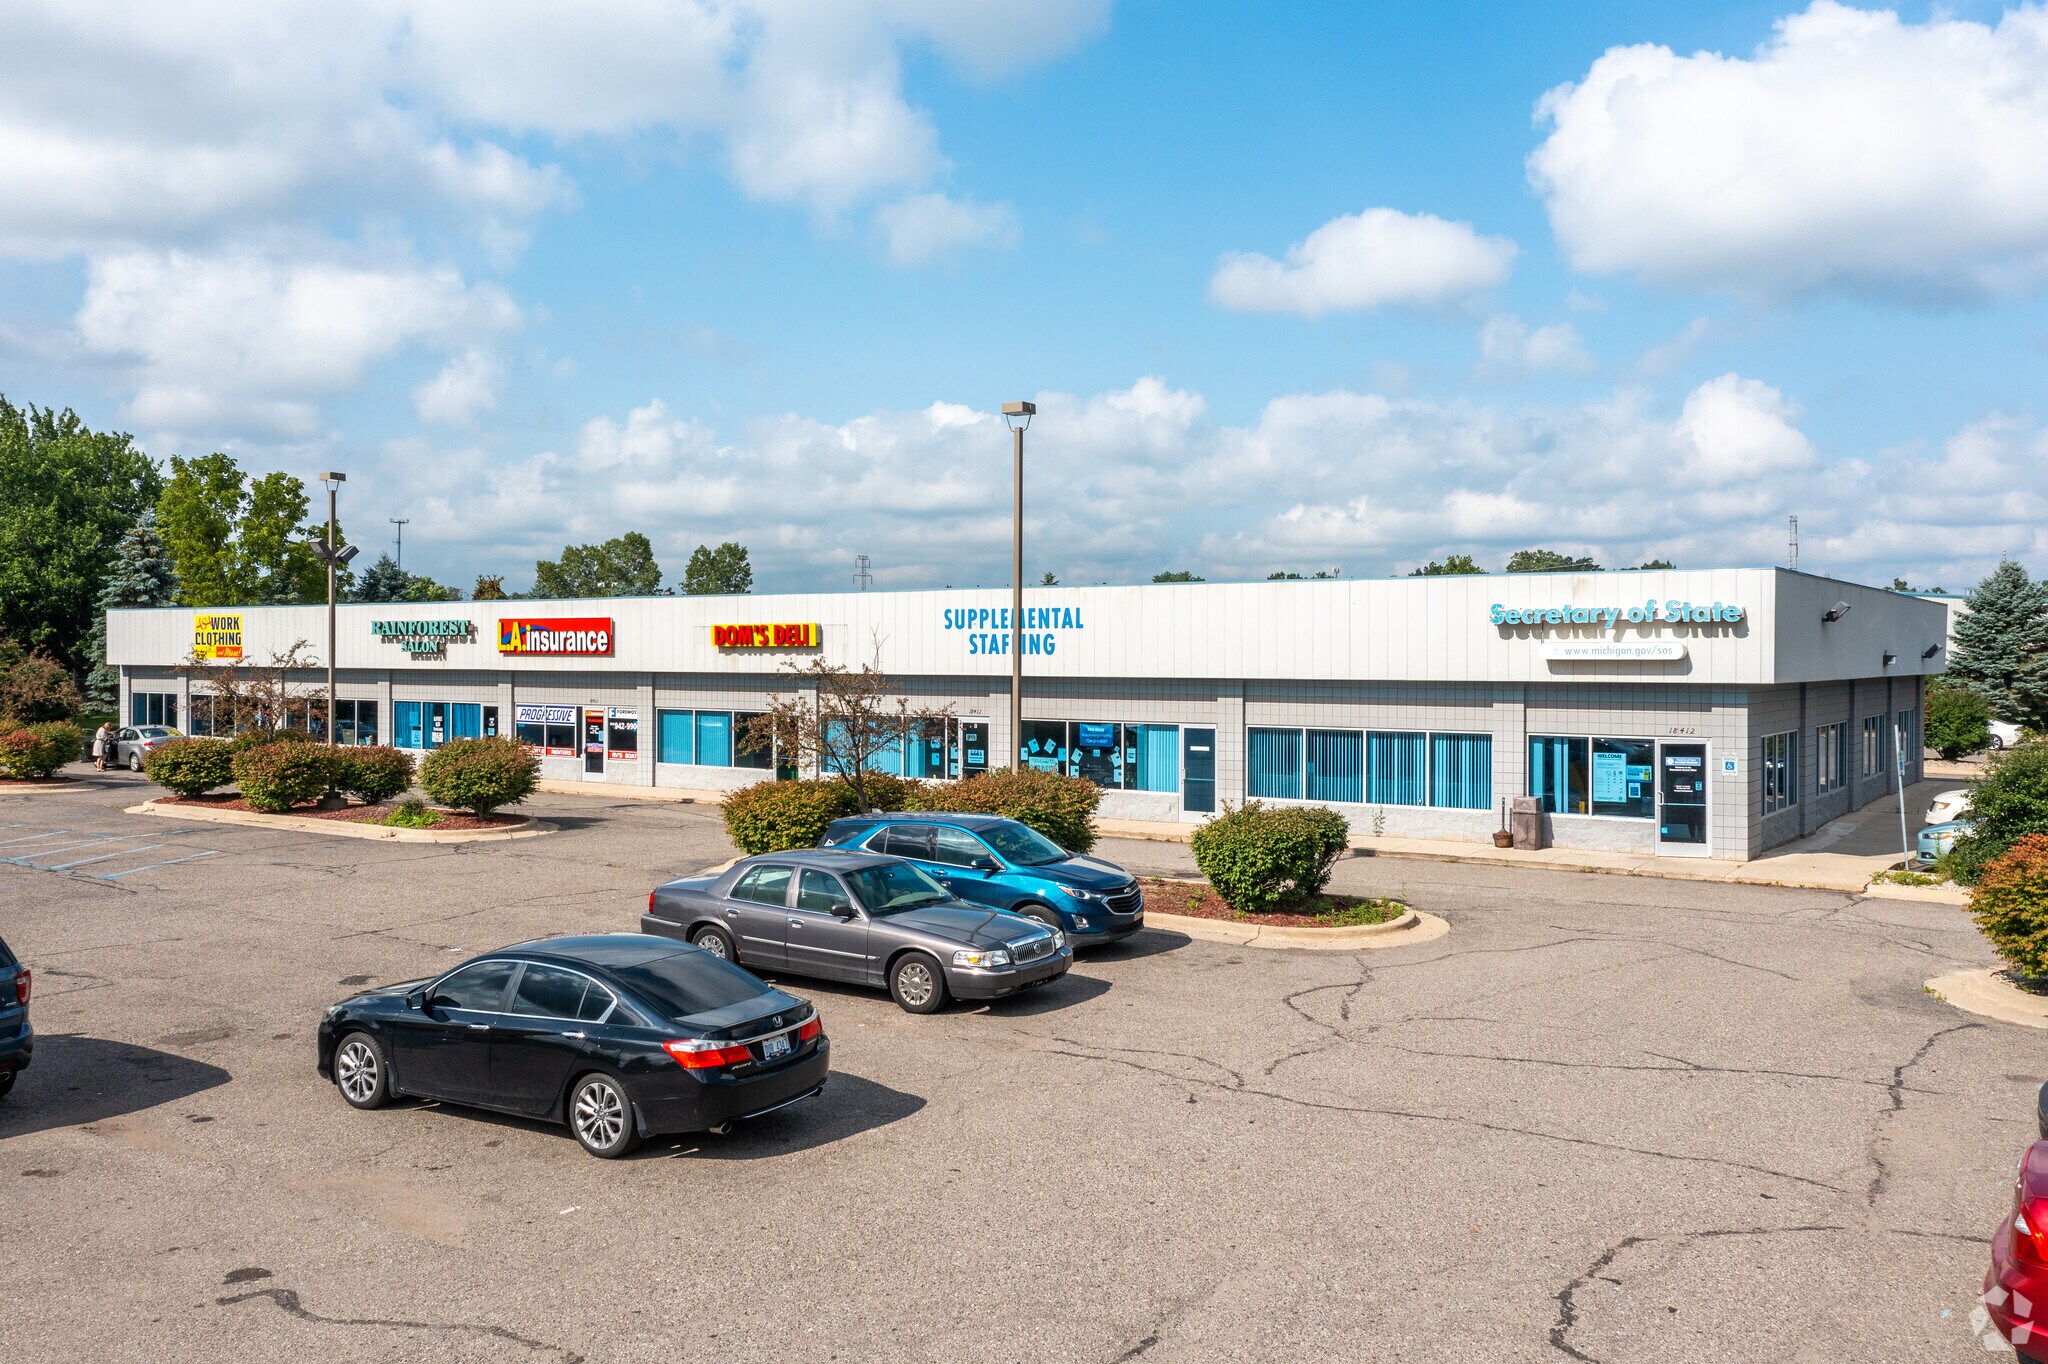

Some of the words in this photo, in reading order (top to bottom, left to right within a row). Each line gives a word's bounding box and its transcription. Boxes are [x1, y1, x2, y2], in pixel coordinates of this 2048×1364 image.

[1490, 603, 1620, 629] Secretary
[1628, 599, 1657, 623] of
[1664, 599, 1742, 623] State
[211, 617, 240, 630] WORK
[371, 620, 468, 635] RAINFOREST
[195, 632, 241, 645] CLOTHING
[714, 624, 769, 645] DOM'S
[774, 624, 808, 645] DELI
[401, 641, 437, 652] SALON
[969, 633, 1055, 655] STAFING
[1564, 644, 1673, 657] www.michigan.gov/sos
[1669, 727, 1695, 735] 18412
